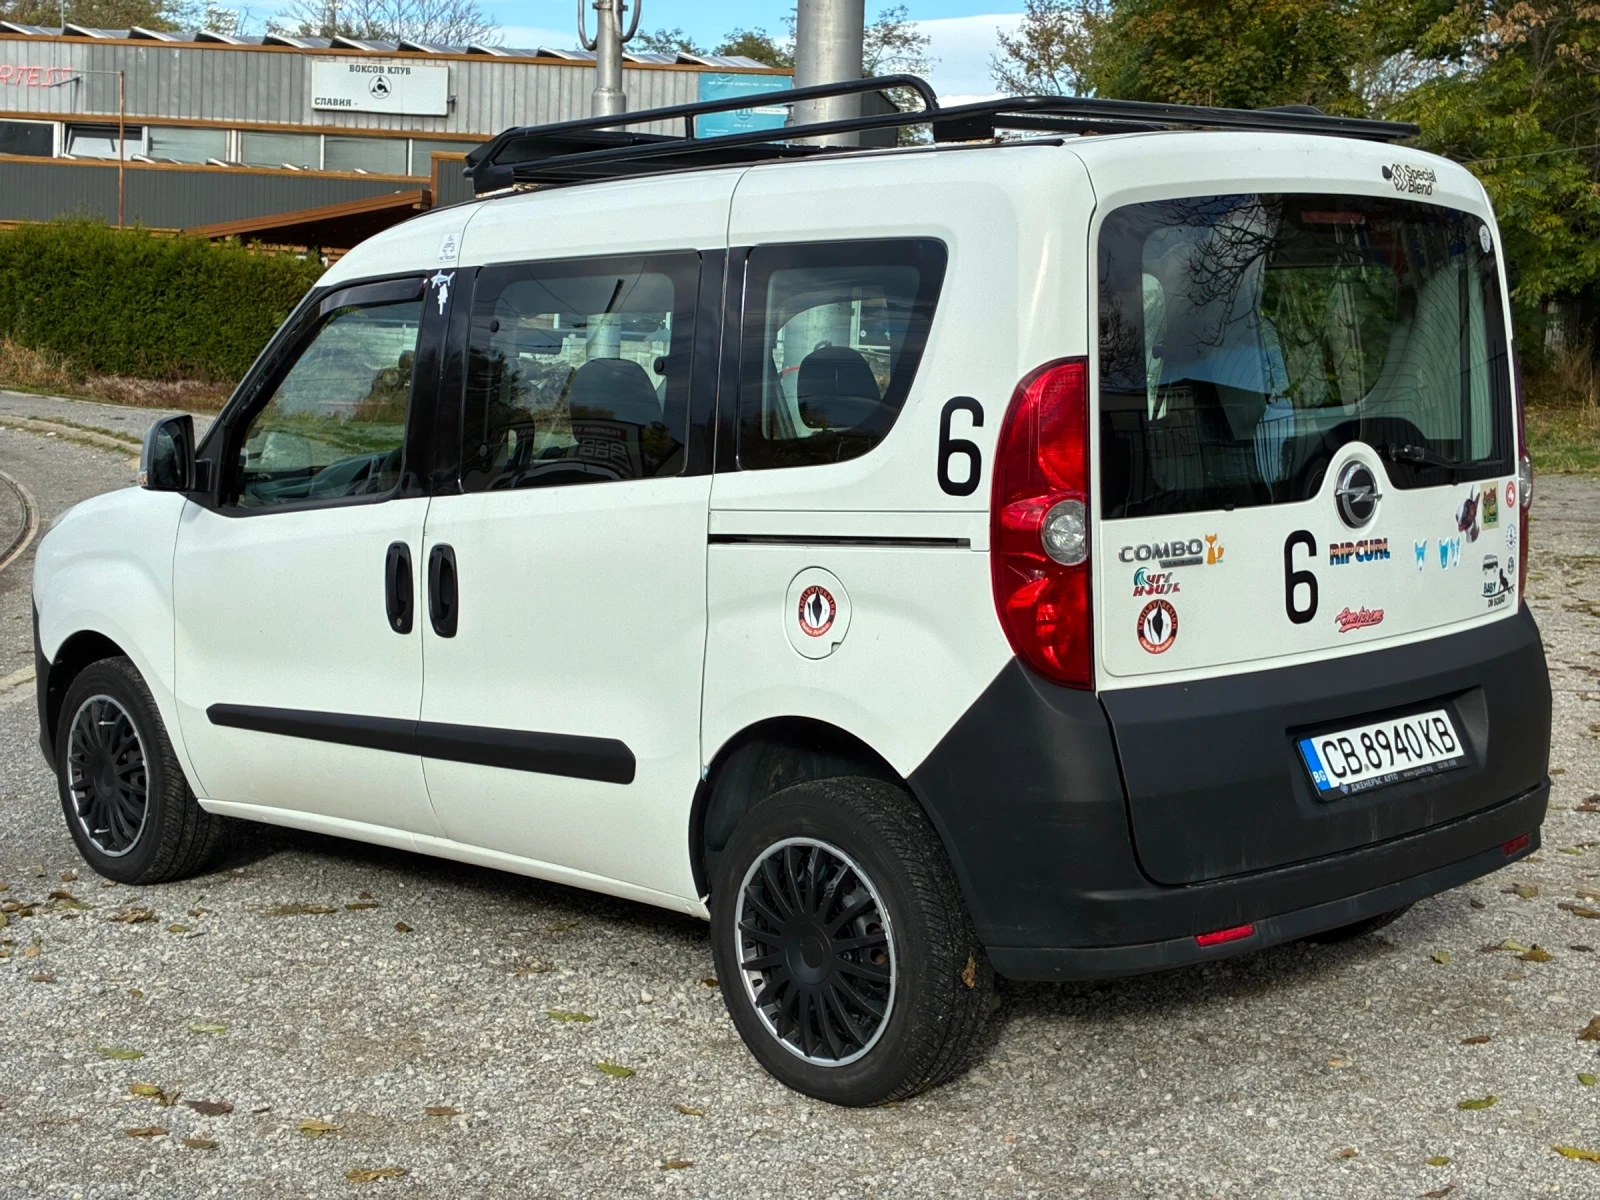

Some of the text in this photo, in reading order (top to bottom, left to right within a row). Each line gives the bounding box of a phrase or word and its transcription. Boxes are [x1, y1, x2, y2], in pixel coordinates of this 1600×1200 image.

[349, 64, 411, 75] БОКСОВ КЛУБ
[314, 97, 352, 107] СЛАВИЯ
[1404, 164, 1437, 183] Special
[1408, 179, 1433, 196] Blend
[937, 395, 985, 497] 6
[1118, 538, 1203, 563] COMBO
[1284, 529, 1319, 625] 6
[1312, 770, 1327, 784] BG
